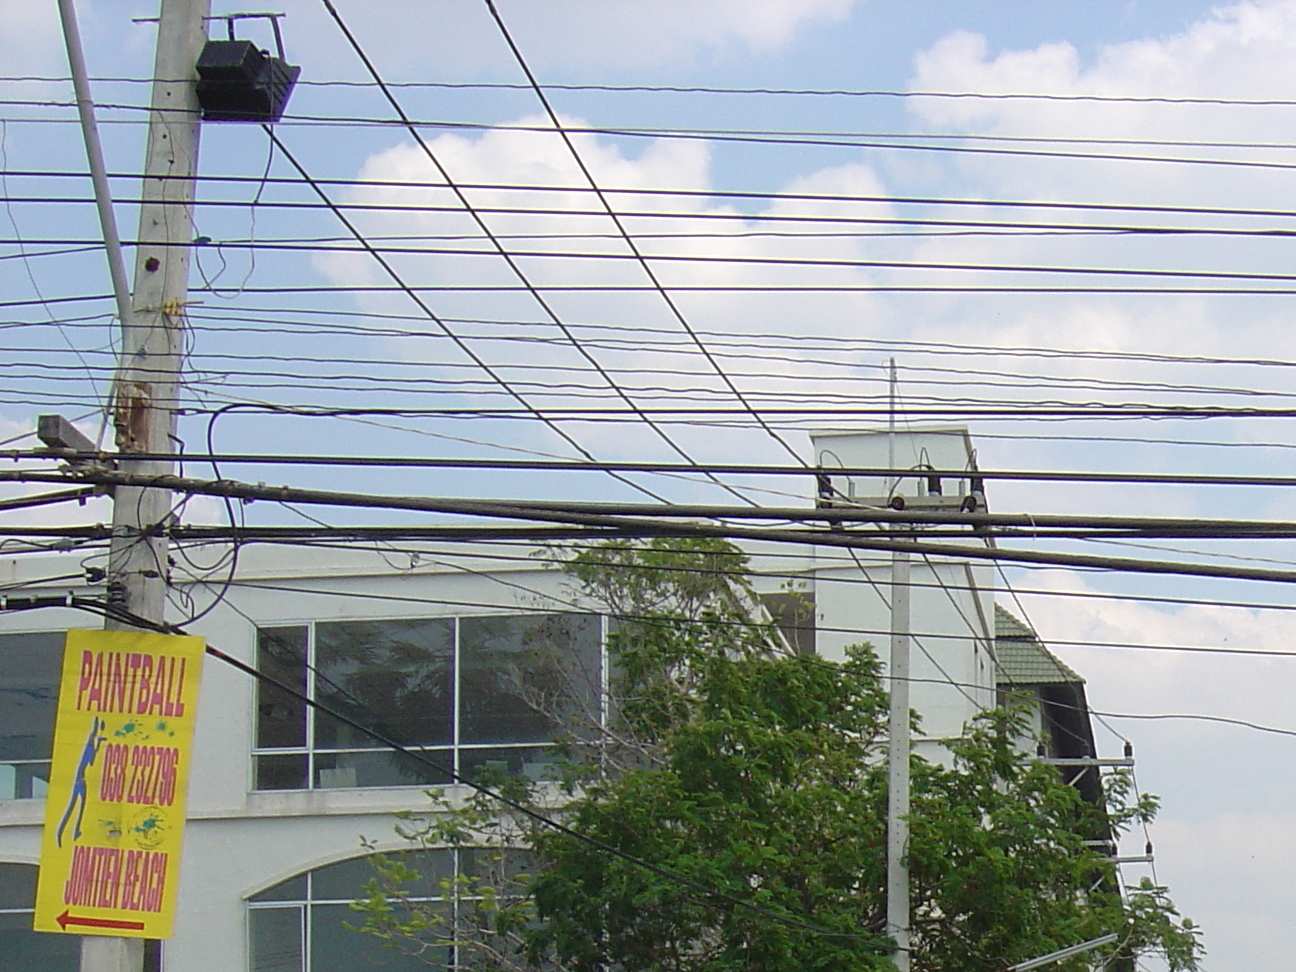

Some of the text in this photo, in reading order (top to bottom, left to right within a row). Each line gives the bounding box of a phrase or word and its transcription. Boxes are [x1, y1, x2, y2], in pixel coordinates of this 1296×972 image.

[76, 649, 187, 718] PAINTBALL
[100, 742, 180, 806] 038 232796
[63, 845, 169, 913] JOMTIEN BEACH
